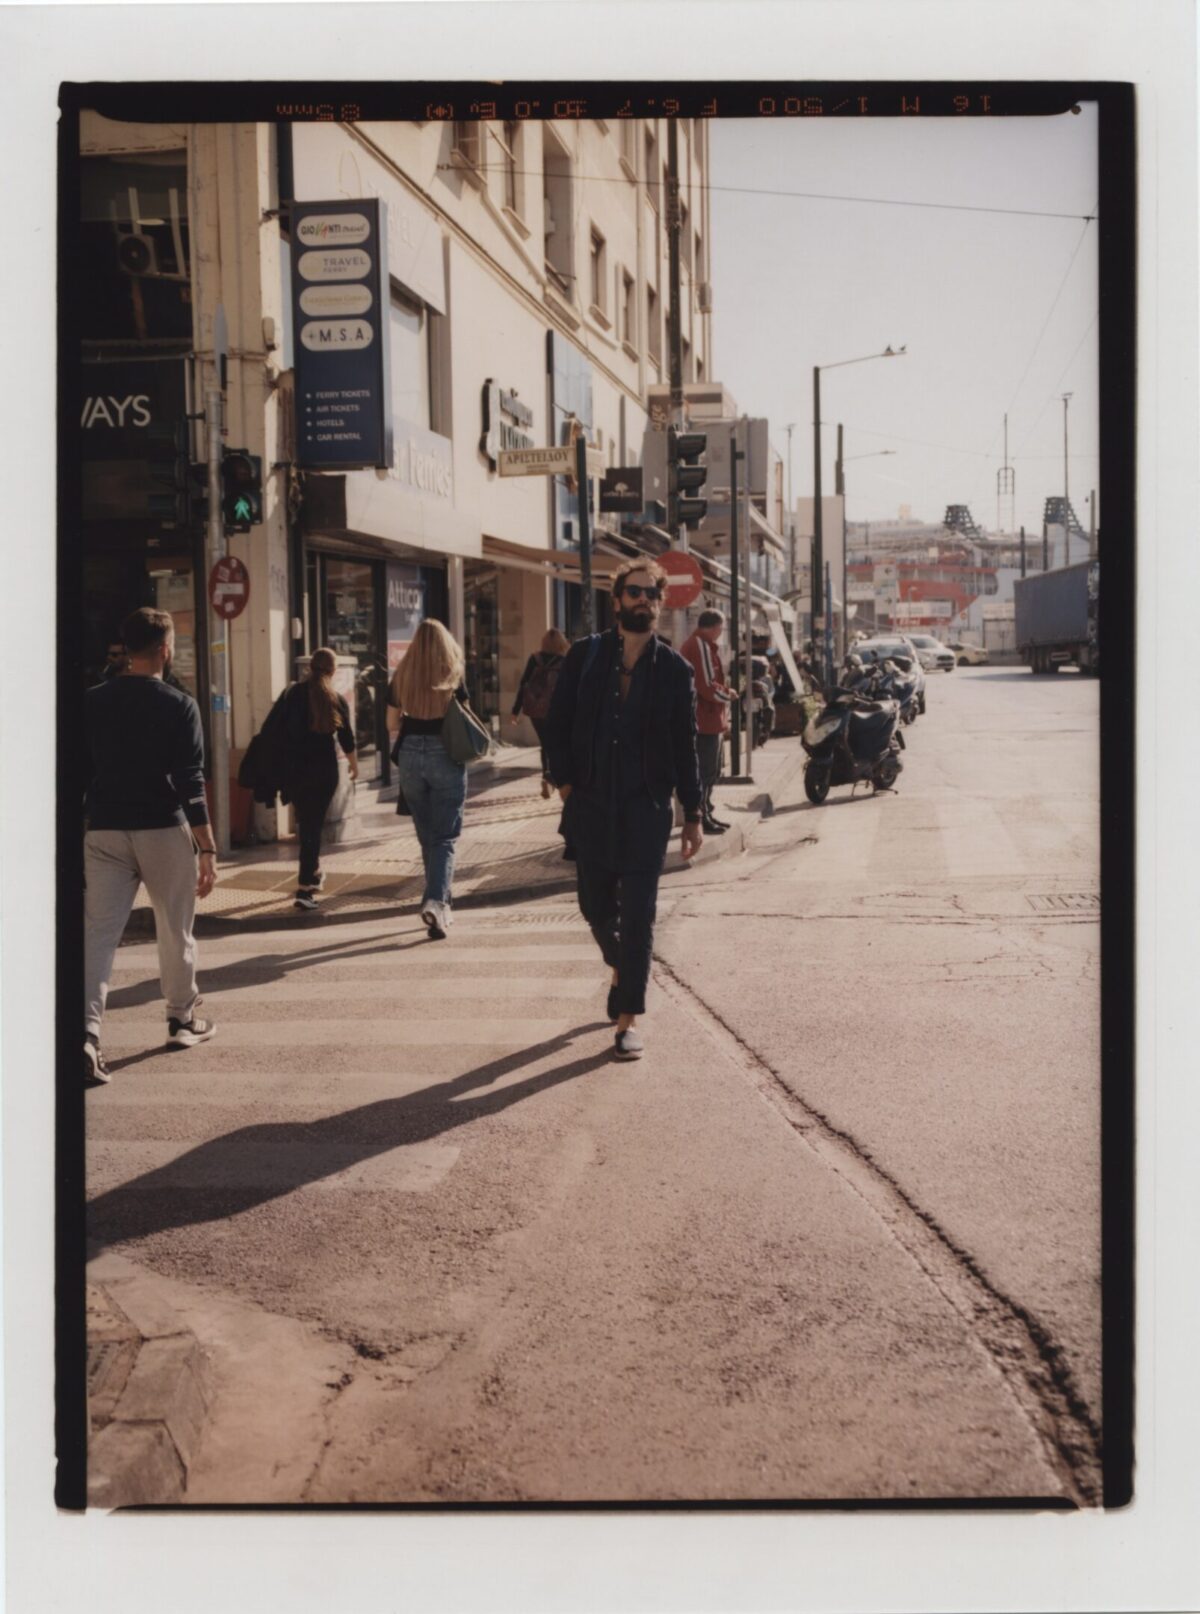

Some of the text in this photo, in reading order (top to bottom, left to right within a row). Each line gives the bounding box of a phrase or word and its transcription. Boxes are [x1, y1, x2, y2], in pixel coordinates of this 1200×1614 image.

[322, 257, 367, 267] TRAVEL
[341, 389, 371, 398] TICKETS
[316, 404, 360, 413] AIR TICKETS
[316, 419, 345, 427] HOTELS
[317, 432, 362, 441] CAR RENTAL
[506, 450, 569, 465] ΑΡΙΣΤΕΙΔΟΥ
